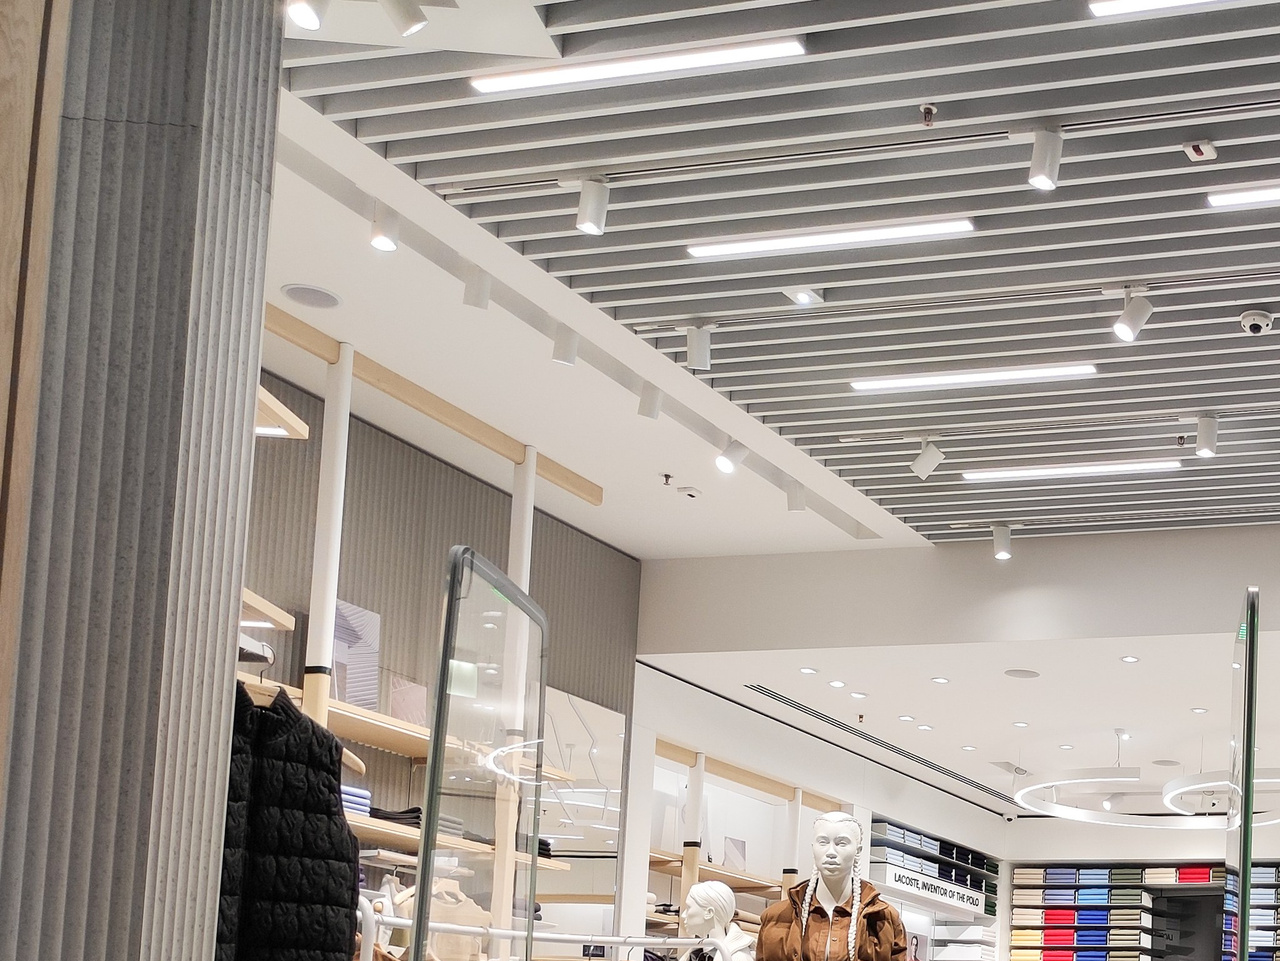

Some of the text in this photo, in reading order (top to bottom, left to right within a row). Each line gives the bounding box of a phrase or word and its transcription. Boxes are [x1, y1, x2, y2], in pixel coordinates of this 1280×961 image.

[894, 873, 979, 907] LACOSTE, INVENTOR OF THE POLO
